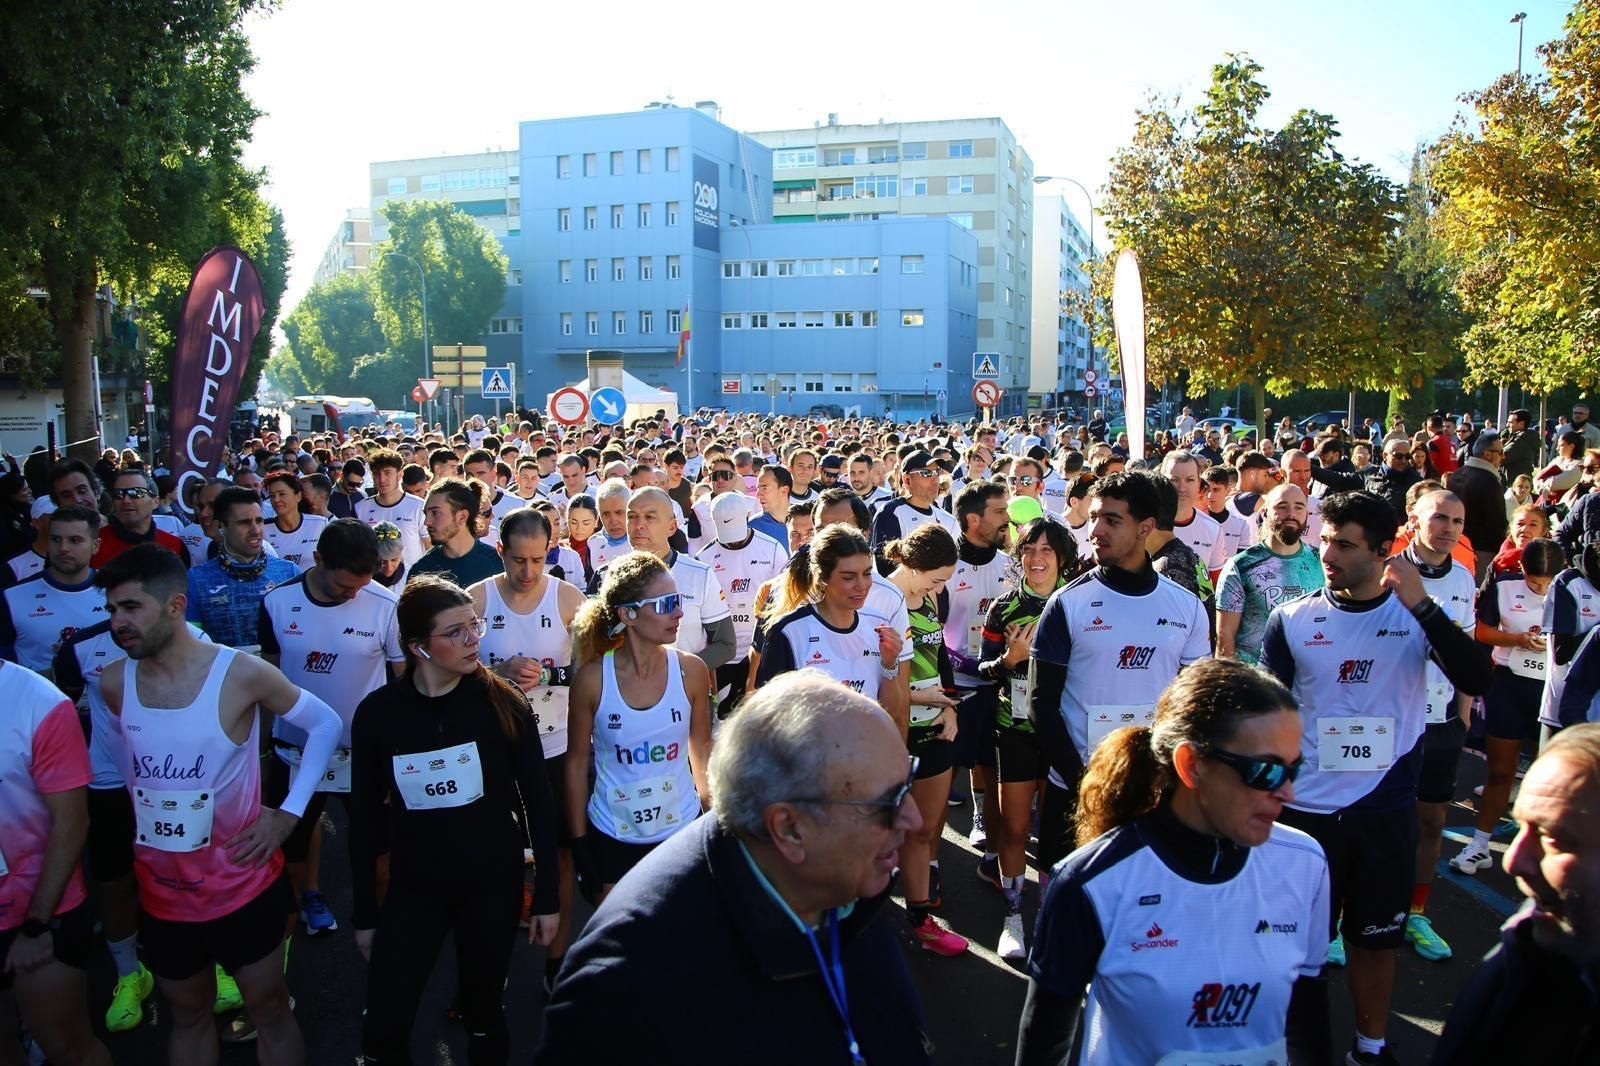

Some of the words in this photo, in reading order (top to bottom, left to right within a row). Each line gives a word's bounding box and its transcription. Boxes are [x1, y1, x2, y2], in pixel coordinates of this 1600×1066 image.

[694, 181, 718, 211] 200
[732, 614, 750, 622] 802
[356, 630, 375, 638] mupol
[1389, 629, 1410, 638] mupol
[1523, 659, 1545, 671] 556
[1341, 745, 1372, 759] 708
[140, 754, 206, 779] Salud
[425, 779, 458, 796] 668
[633, 806, 662, 824] 337
[154, 821, 185, 838] 854
[1272, 921, 1298, 936] mupol
